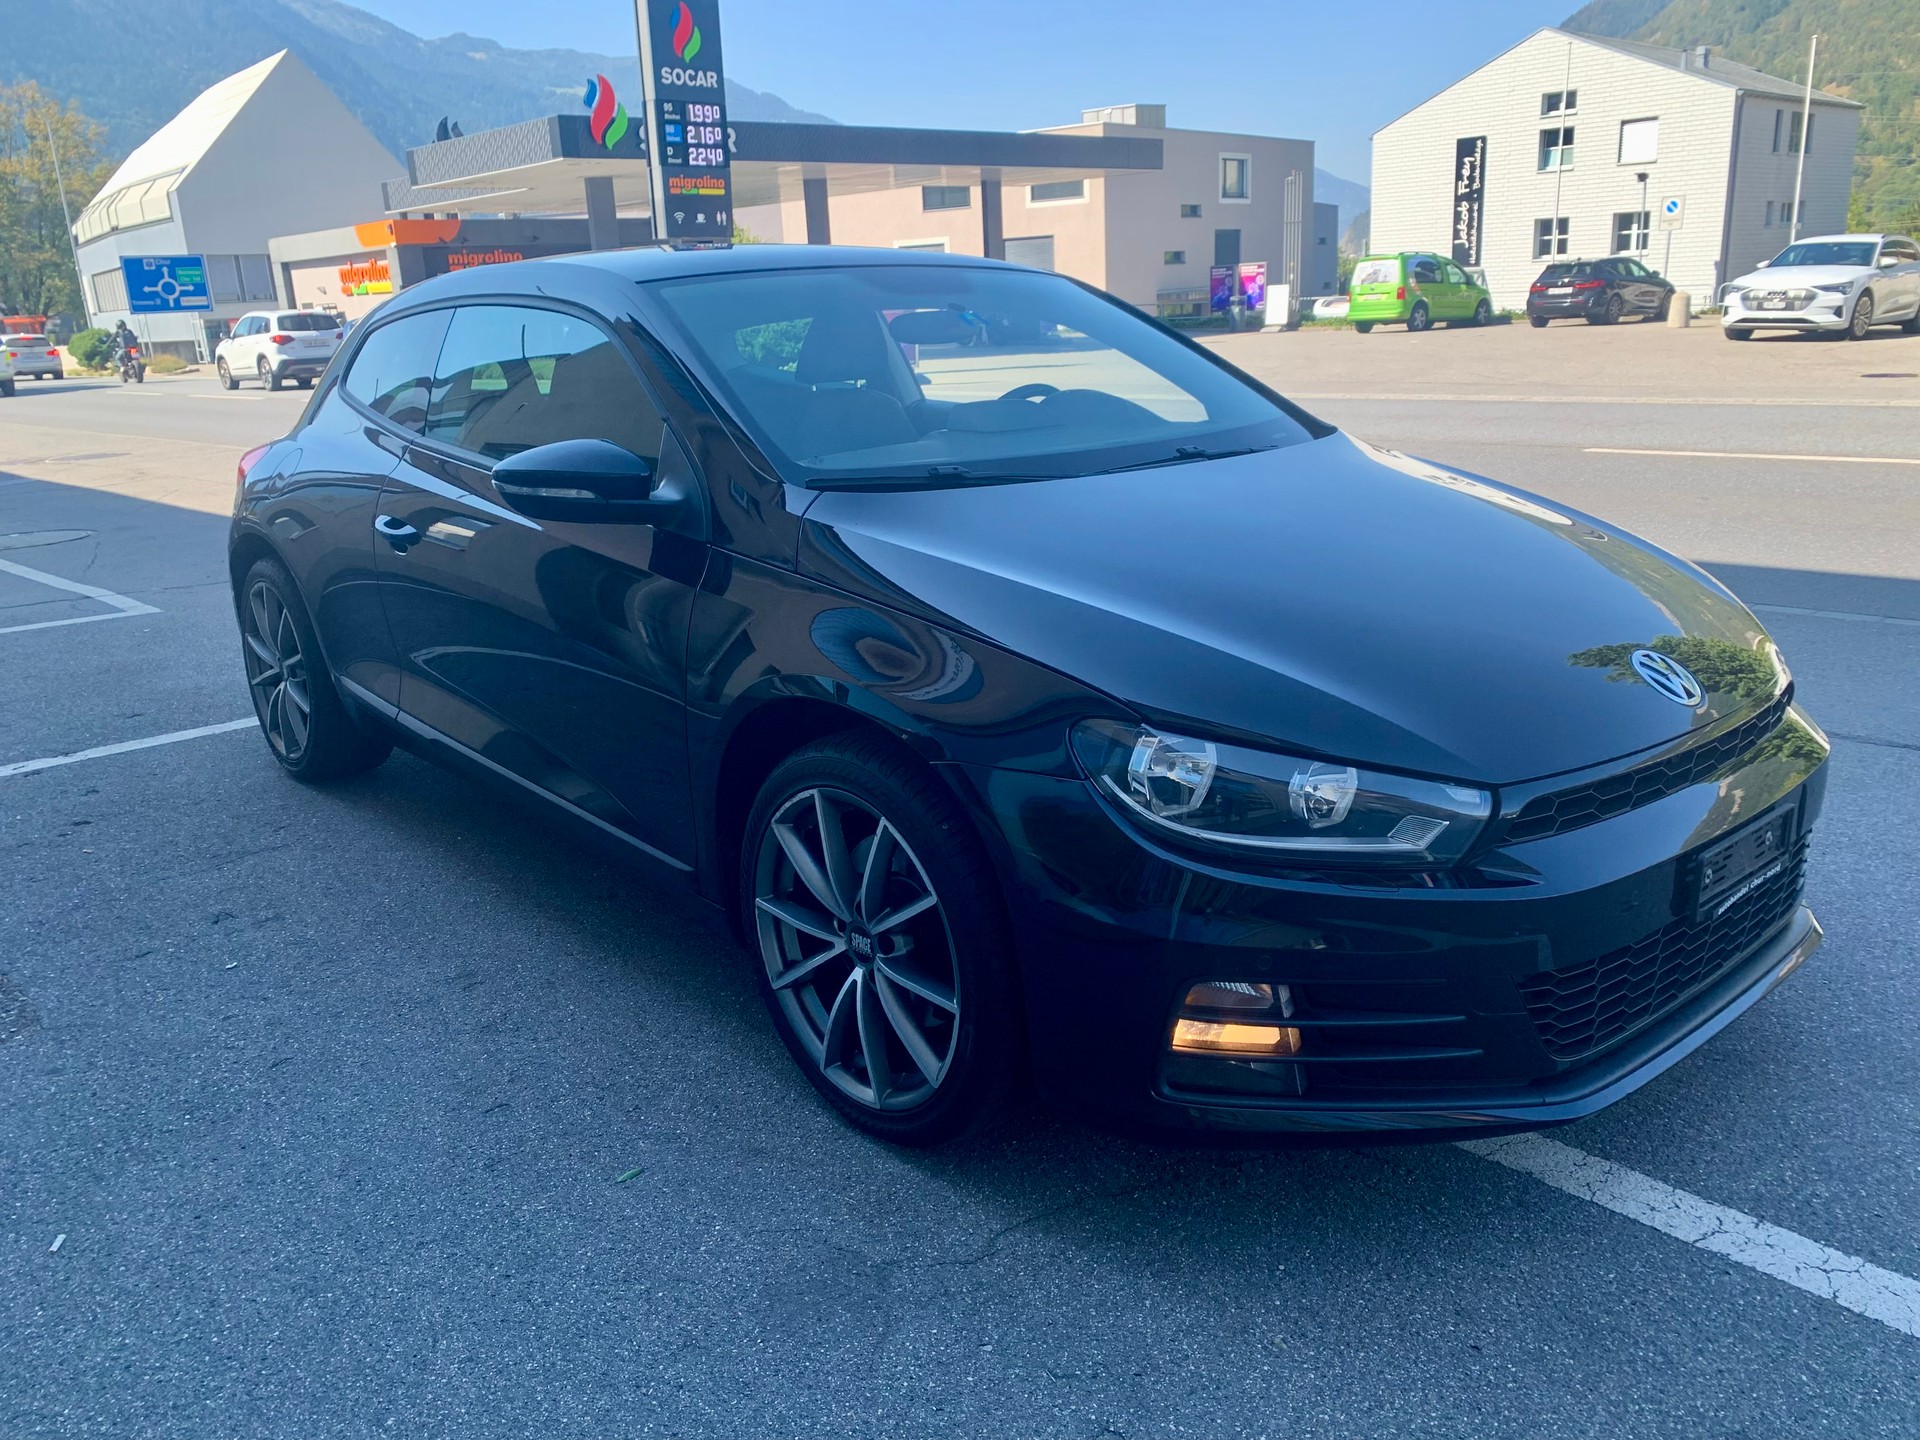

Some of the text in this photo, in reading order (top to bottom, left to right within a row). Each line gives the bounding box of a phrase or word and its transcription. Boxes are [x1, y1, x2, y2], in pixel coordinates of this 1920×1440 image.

[661, 67, 718, 88] SOCAR
[663, 103, 673, 112] 95
[667, 147, 674, 155] D
[669, 174, 725, 190] migrolino
[1454, 157, 1475, 249] Jakob Frey
[447, 249, 523, 267] migrolino
[339, 258, 391, 286] migrolino
[1750, 862, 1782, 889] chur-nord
[851, 932, 871, 952] SPACE
